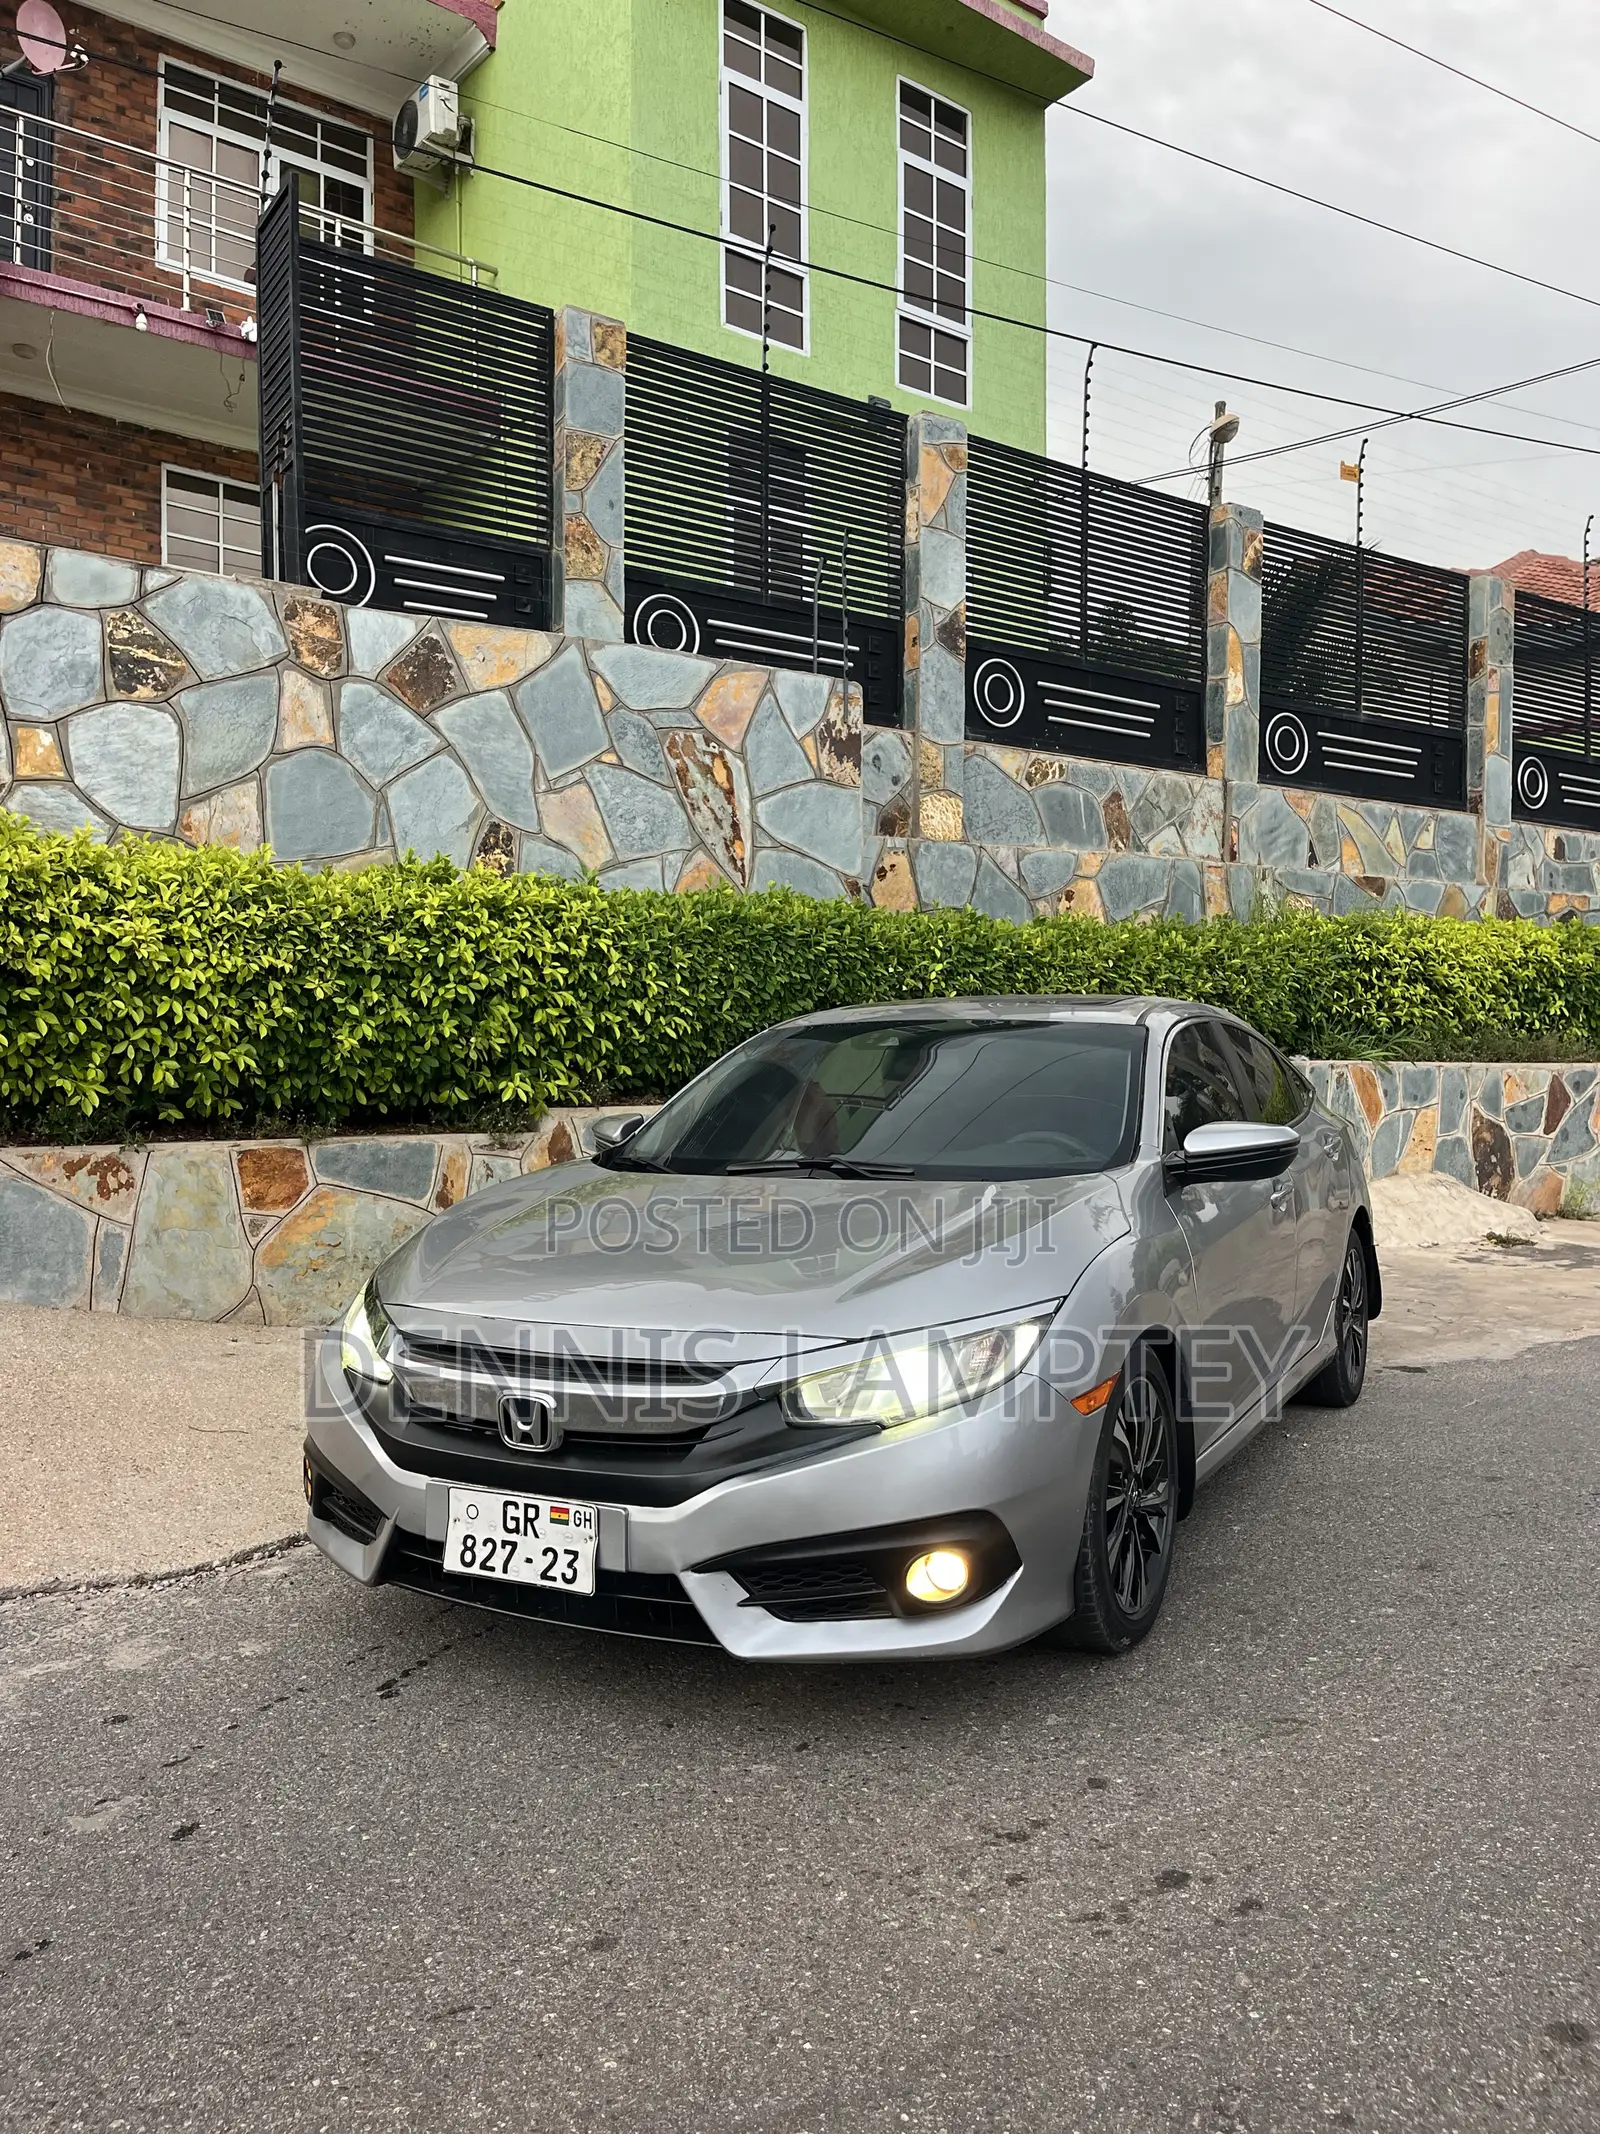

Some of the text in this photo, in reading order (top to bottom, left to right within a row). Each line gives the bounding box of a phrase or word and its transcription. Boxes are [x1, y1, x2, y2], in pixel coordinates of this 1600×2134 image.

[502, 1500, 592, 1539] GR GH
[460, 1534, 579, 1584] 827-23
